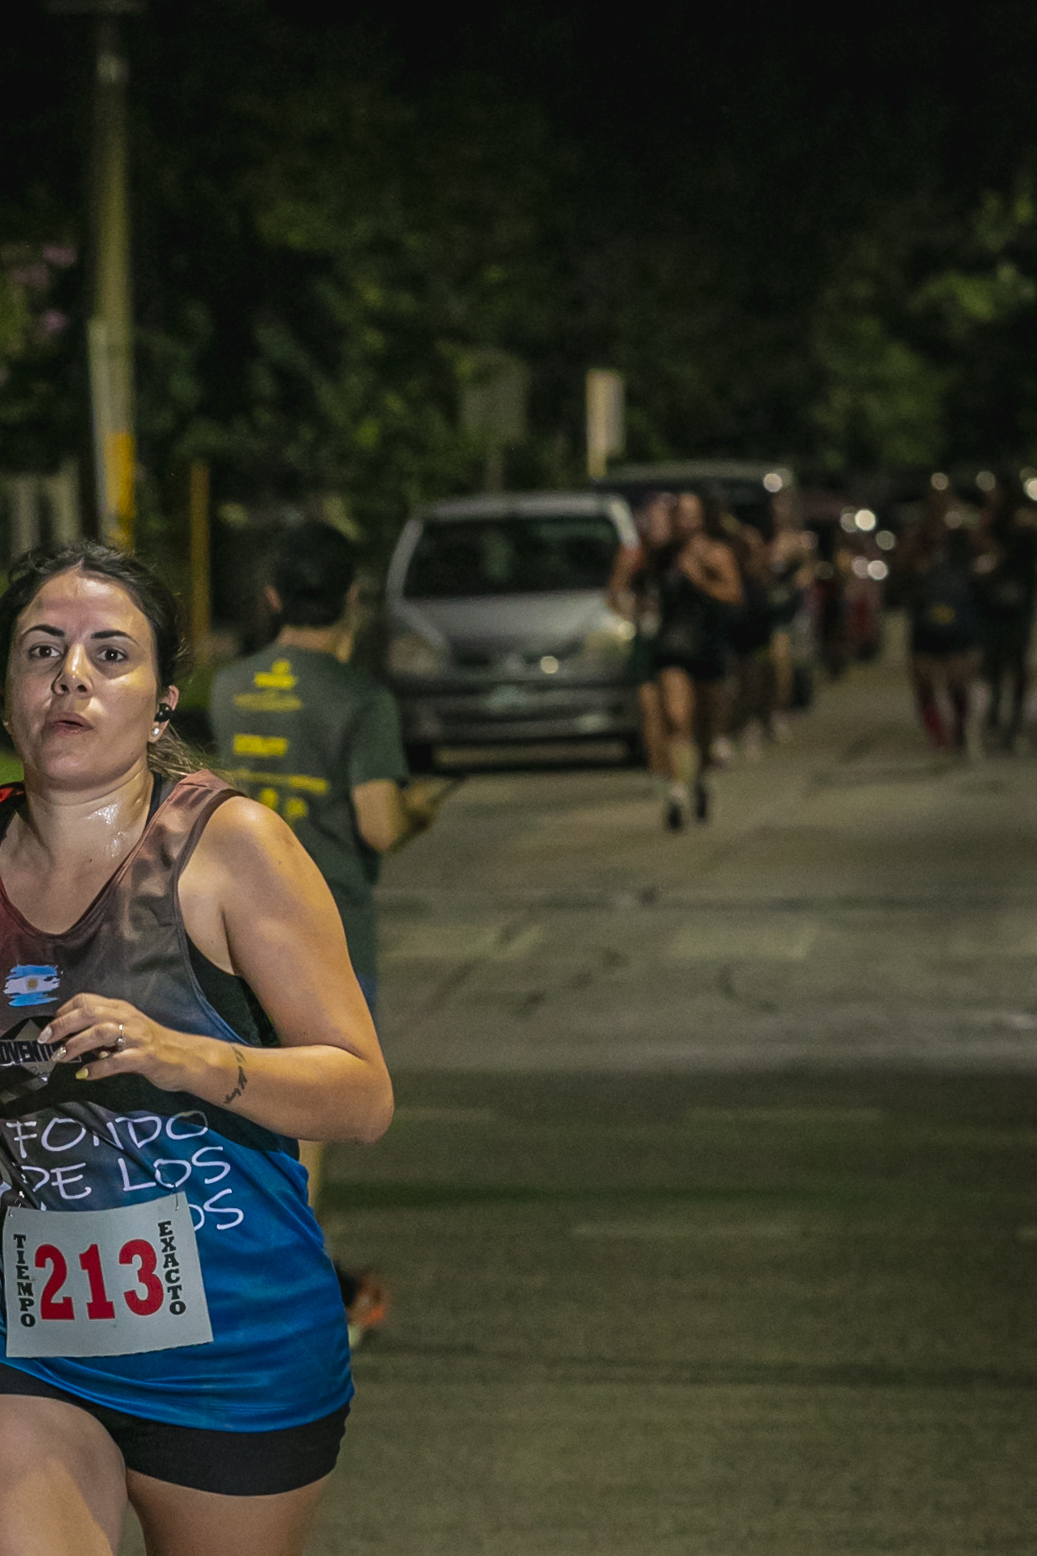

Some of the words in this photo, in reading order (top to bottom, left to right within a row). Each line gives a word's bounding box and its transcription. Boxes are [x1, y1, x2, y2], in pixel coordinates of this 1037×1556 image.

[5, 1110, 209, 1159] FONDO
[12, 1161, 92, 1200] DE
[117, 1145, 231, 1192] LOS
[13, 1233, 37, 1328] TIEMPO
[33, 1238, 165, 1321] 213
[157, 1220, 187, 1316] EXACTO
